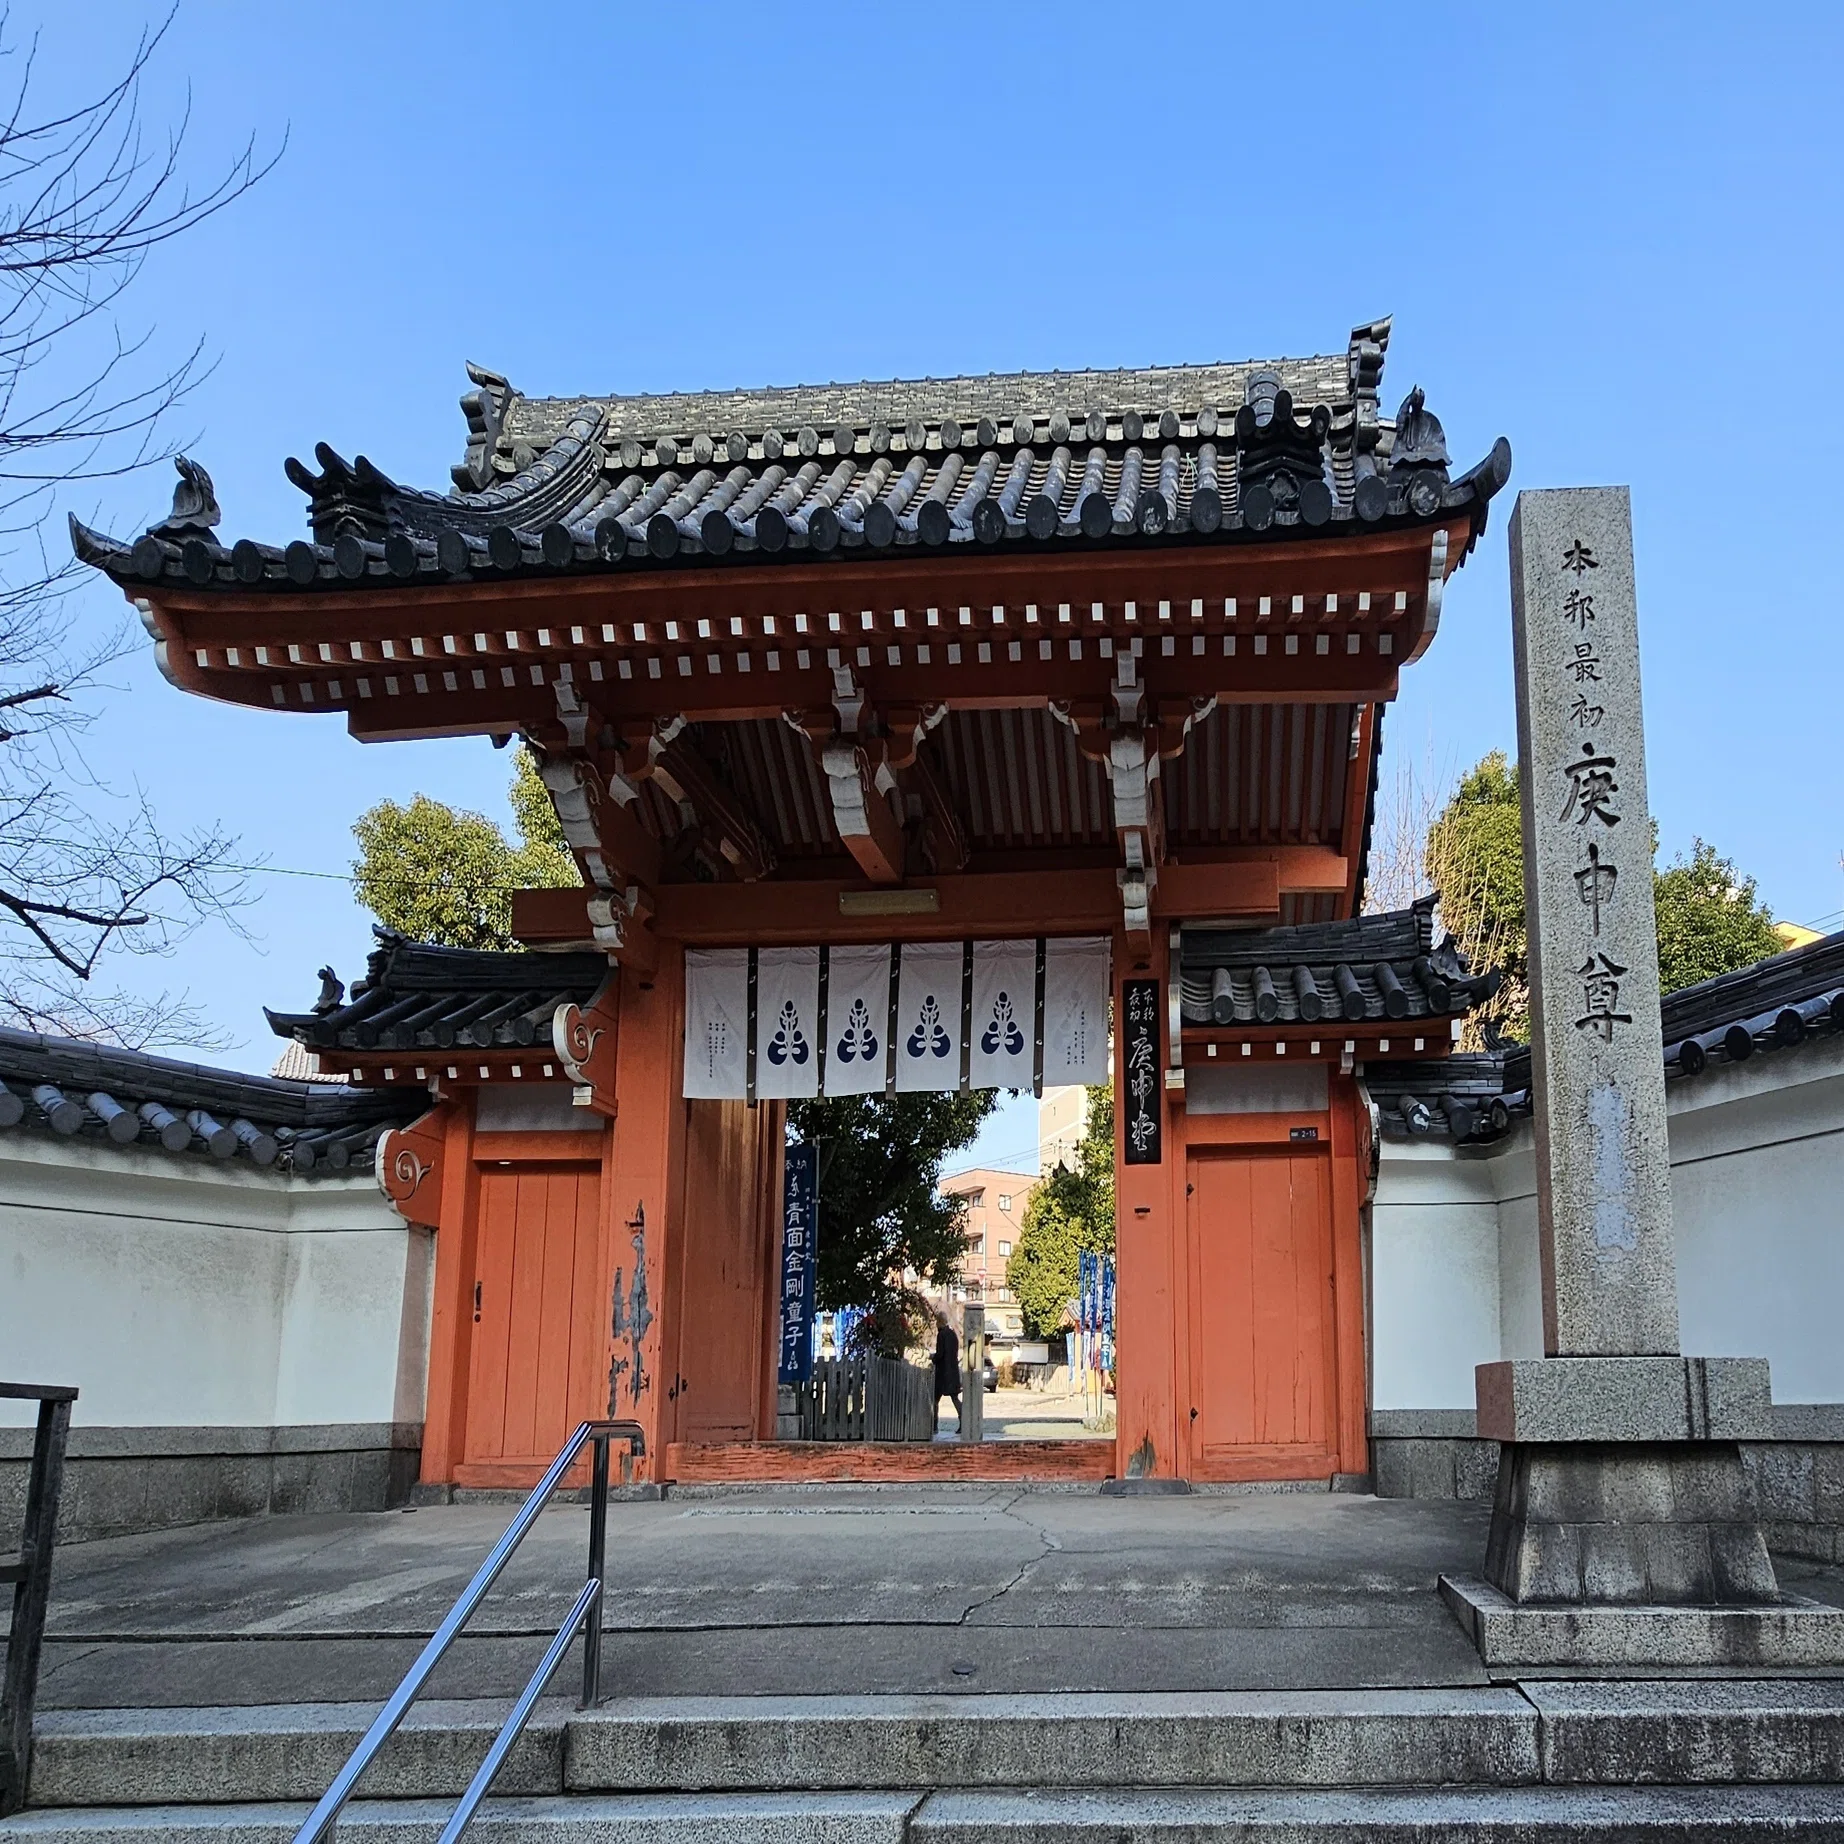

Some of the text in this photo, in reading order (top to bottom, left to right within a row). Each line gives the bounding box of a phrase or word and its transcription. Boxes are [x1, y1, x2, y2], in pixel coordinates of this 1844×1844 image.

[785, 1202, 804, 1347] 青面金剛童子
